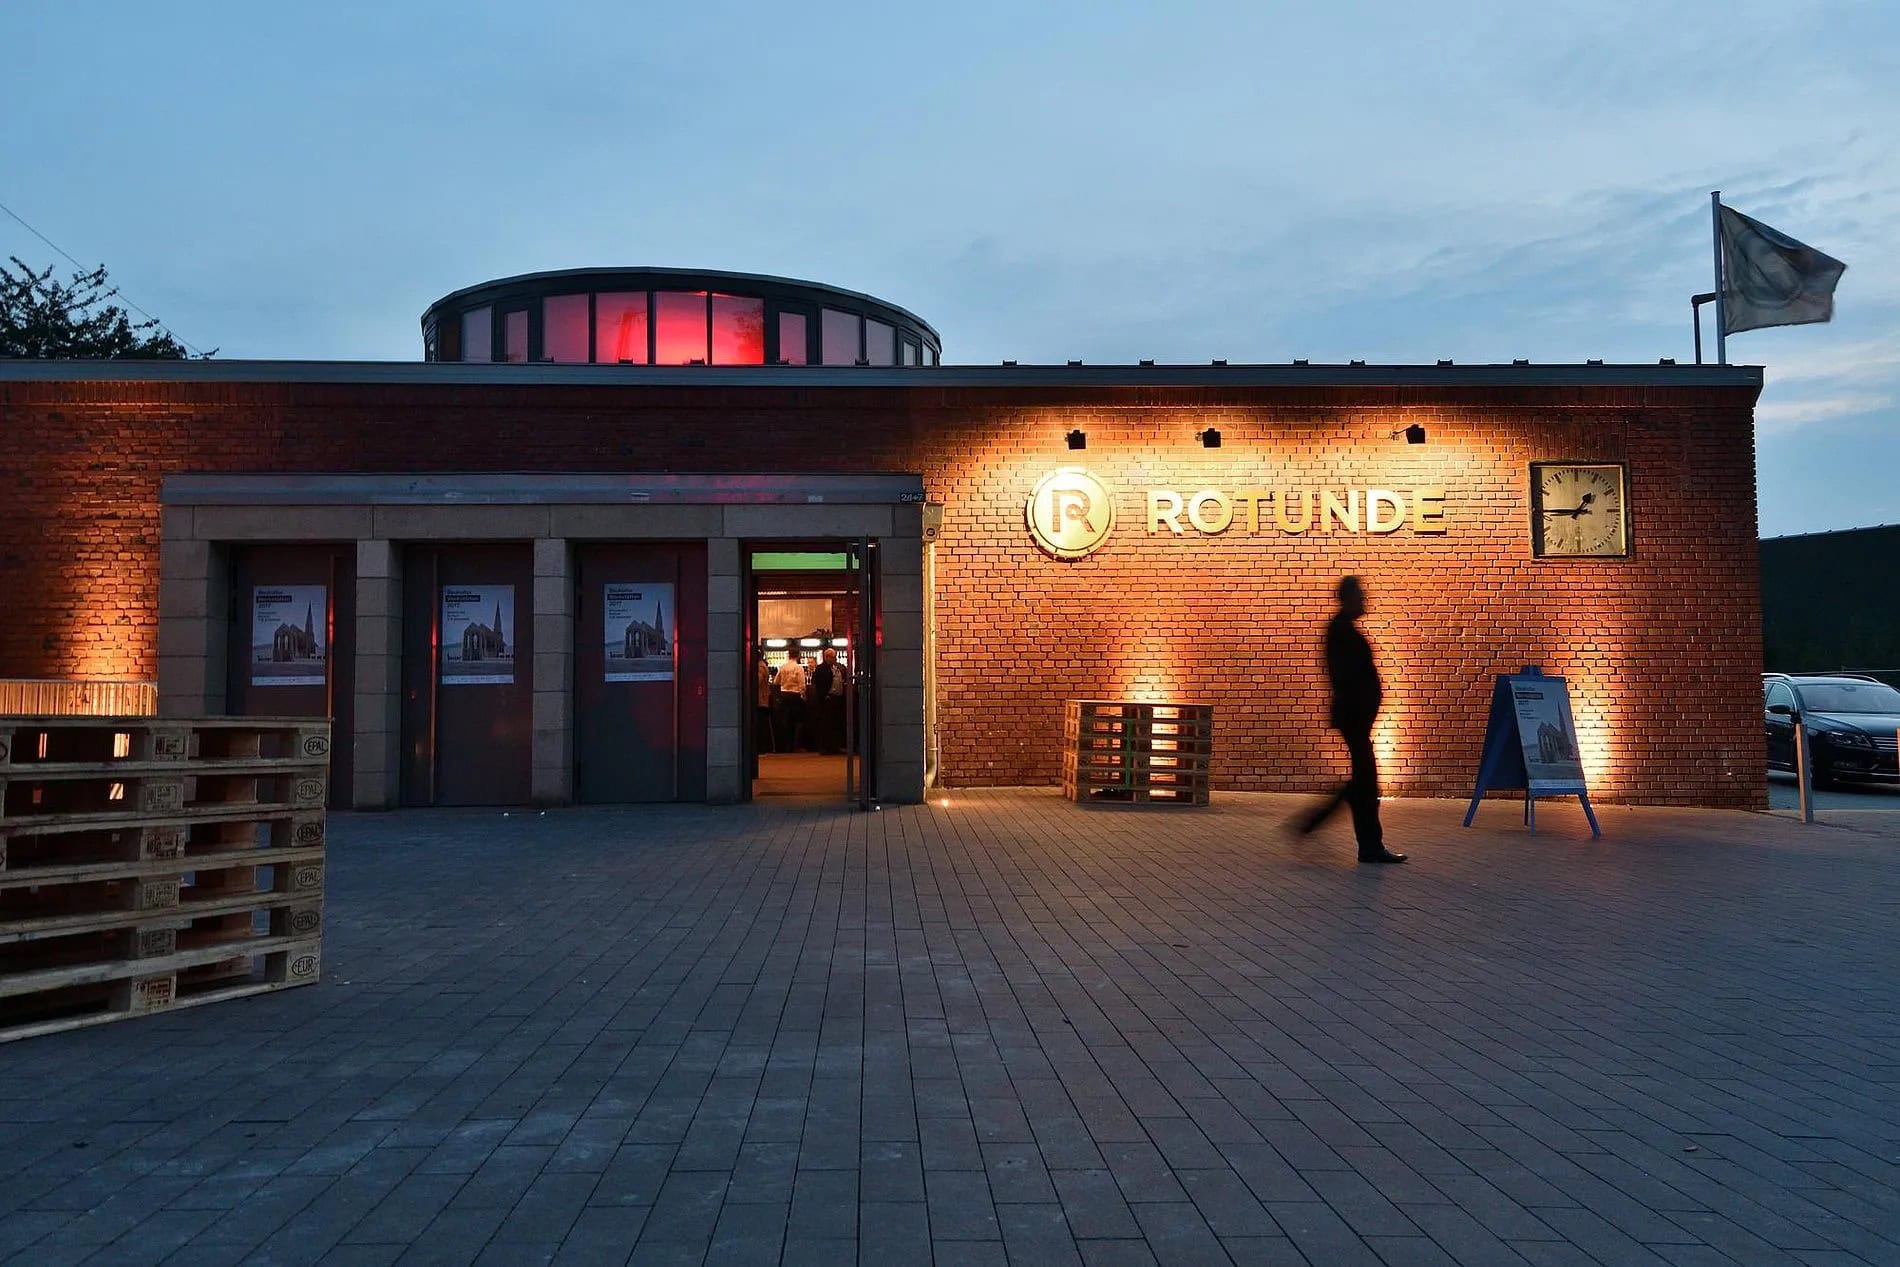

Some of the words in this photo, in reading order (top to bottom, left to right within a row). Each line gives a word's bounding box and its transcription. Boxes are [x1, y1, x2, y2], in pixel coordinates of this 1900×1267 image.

[1146, 489, 1447, 535] ROTUNDE
[300, 783, 318, 795] EPAL
[297, 958, 314, 973] EUR
